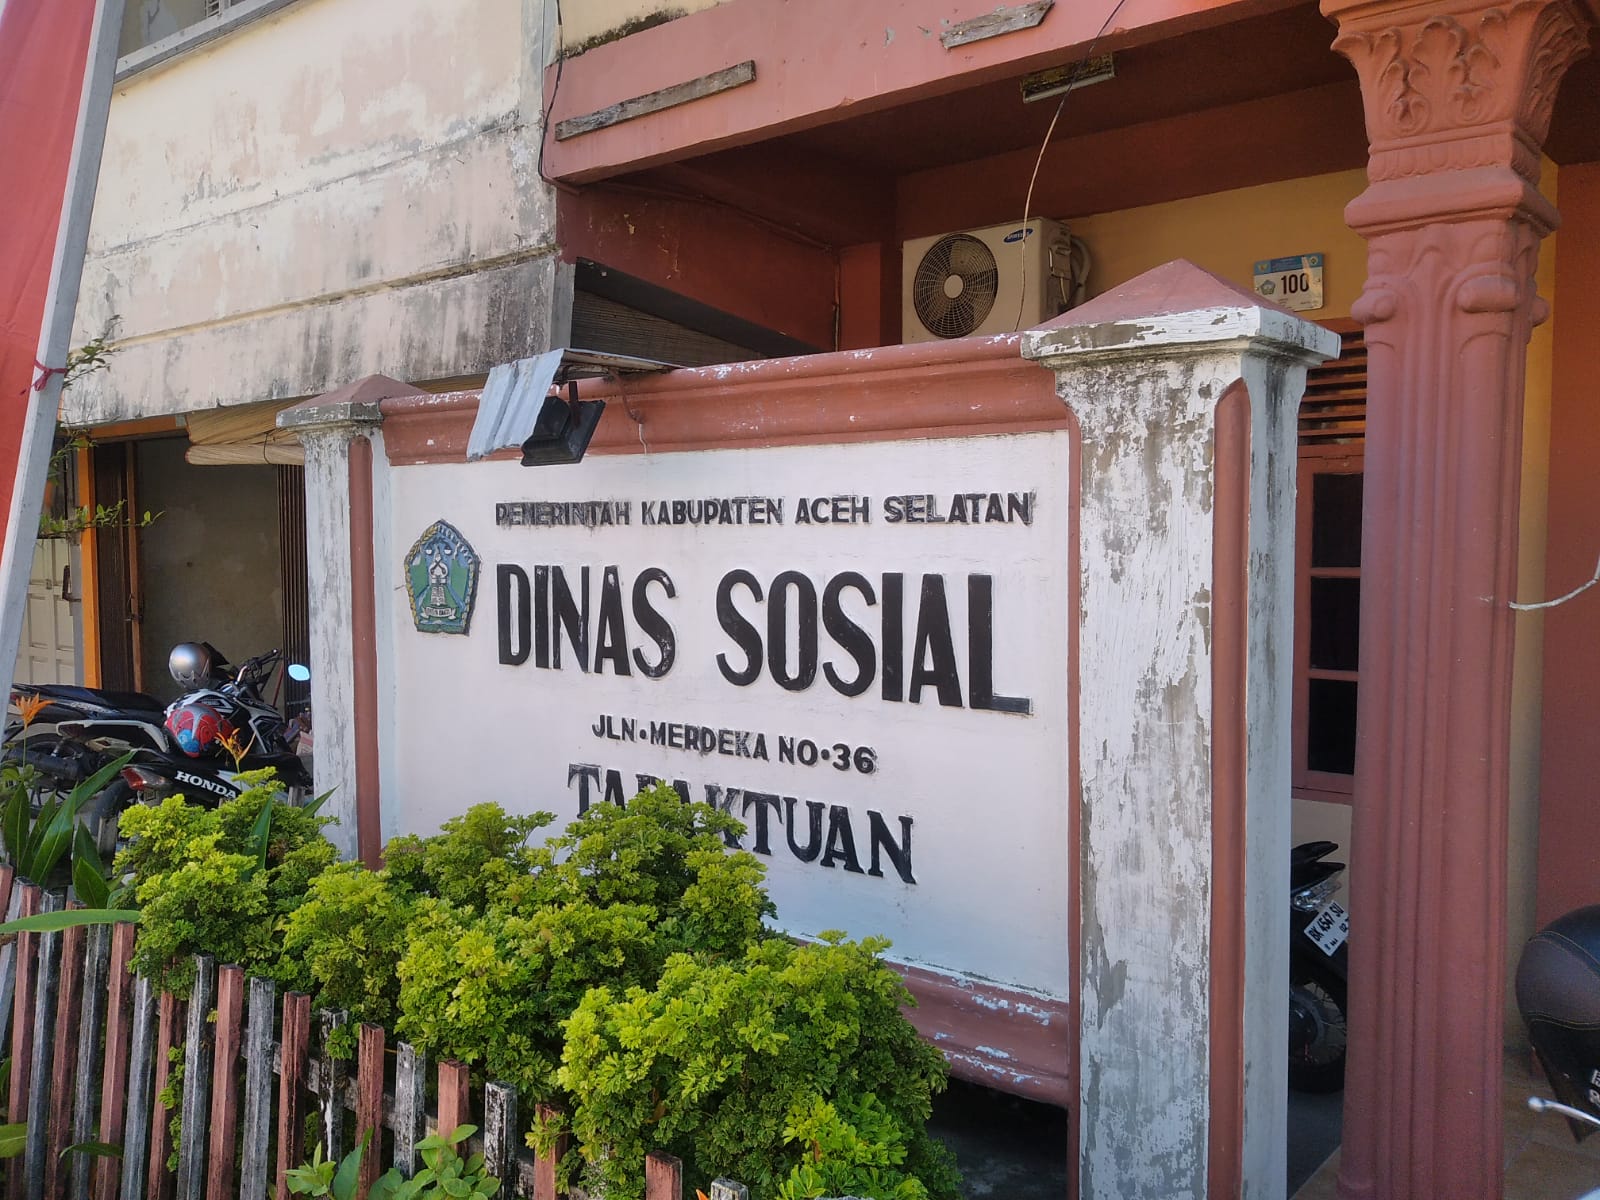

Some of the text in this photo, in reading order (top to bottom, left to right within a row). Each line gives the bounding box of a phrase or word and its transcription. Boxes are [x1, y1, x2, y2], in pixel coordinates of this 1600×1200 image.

[1281, 273, 1309, 295] 100
[496, 492, 1035, 526] PEMERINTAH KABUPATEN ACEH SELATAN
[497, 564, 1031, 714] DINAS SOSIAL
[175, 770, 237, 799] HONDA
